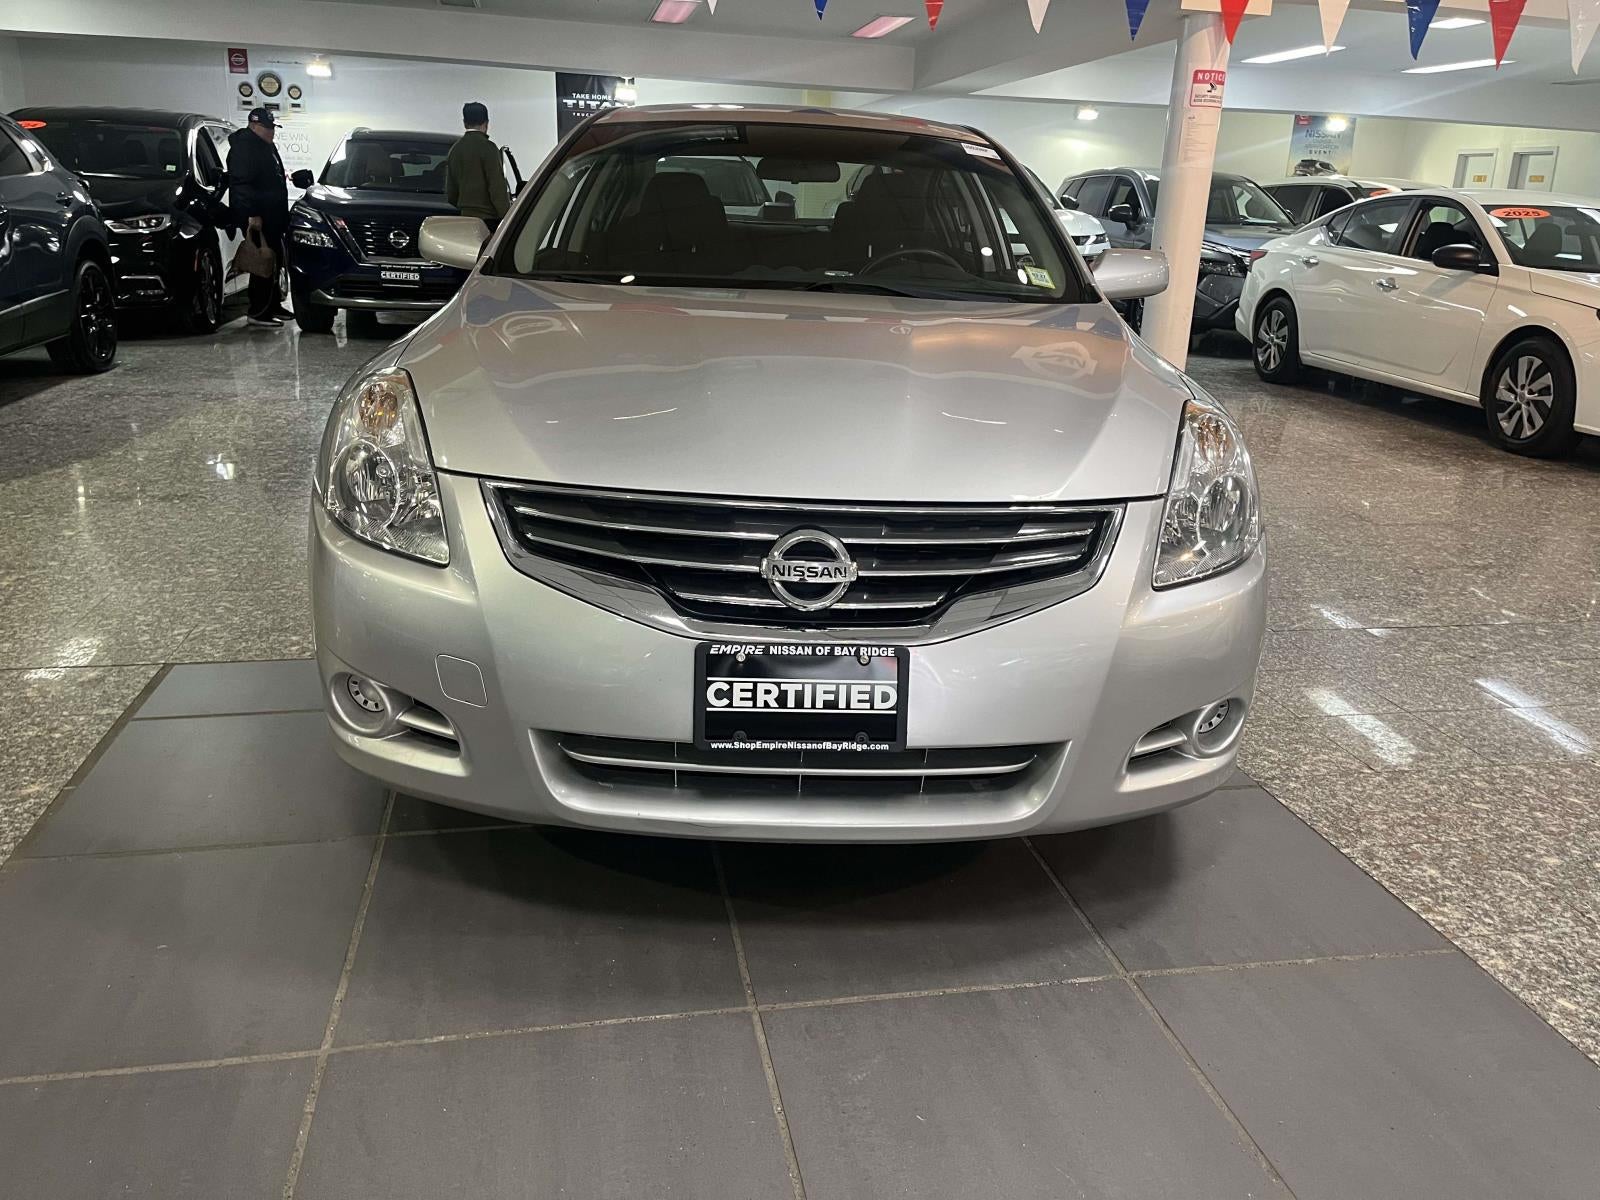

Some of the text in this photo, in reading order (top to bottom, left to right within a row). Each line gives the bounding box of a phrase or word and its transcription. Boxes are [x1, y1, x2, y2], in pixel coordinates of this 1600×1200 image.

[381, 271, 420, 280] CERTIFIED
[771, 564, 847, 578] NISSAN
[710, 645, 896, 657] EMPIRE NISSAN OF BAY RIDGE
[706, 682, 898, 710] CERTIFIED
[710, 741, 890, 752] www.ShopEmpireNissanofBayRidge.com
